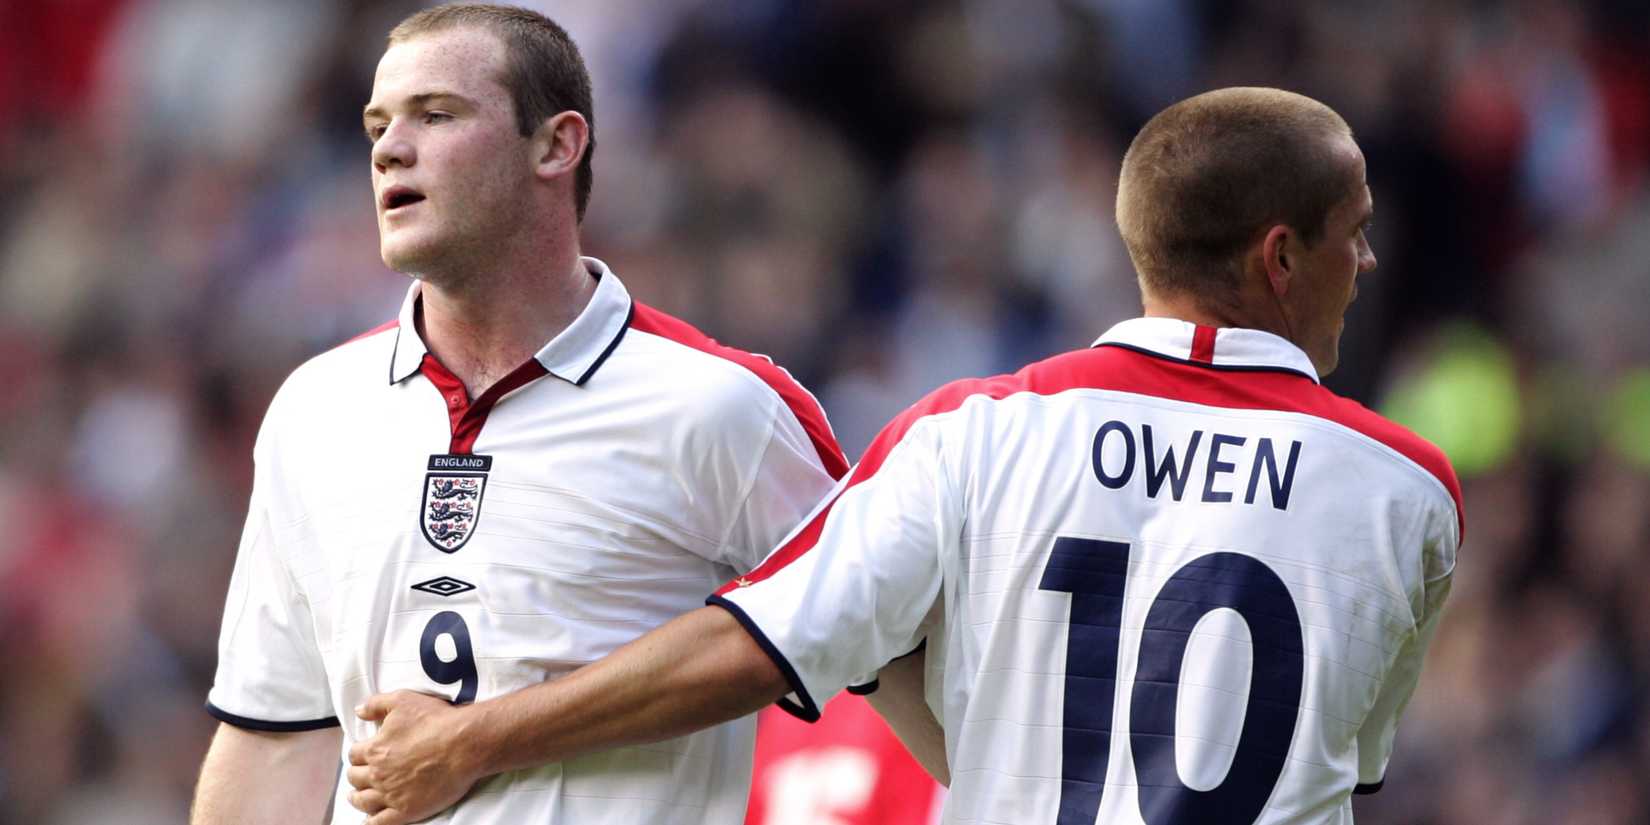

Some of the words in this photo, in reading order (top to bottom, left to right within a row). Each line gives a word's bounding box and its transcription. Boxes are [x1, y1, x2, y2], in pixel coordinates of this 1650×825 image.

[434, 457, 484, 468] ENGLAND
[1092, 420, 1302, 511] OWEN
[420, 611, 478, 704] 9
[1039, 537, 1304, 825] 10
